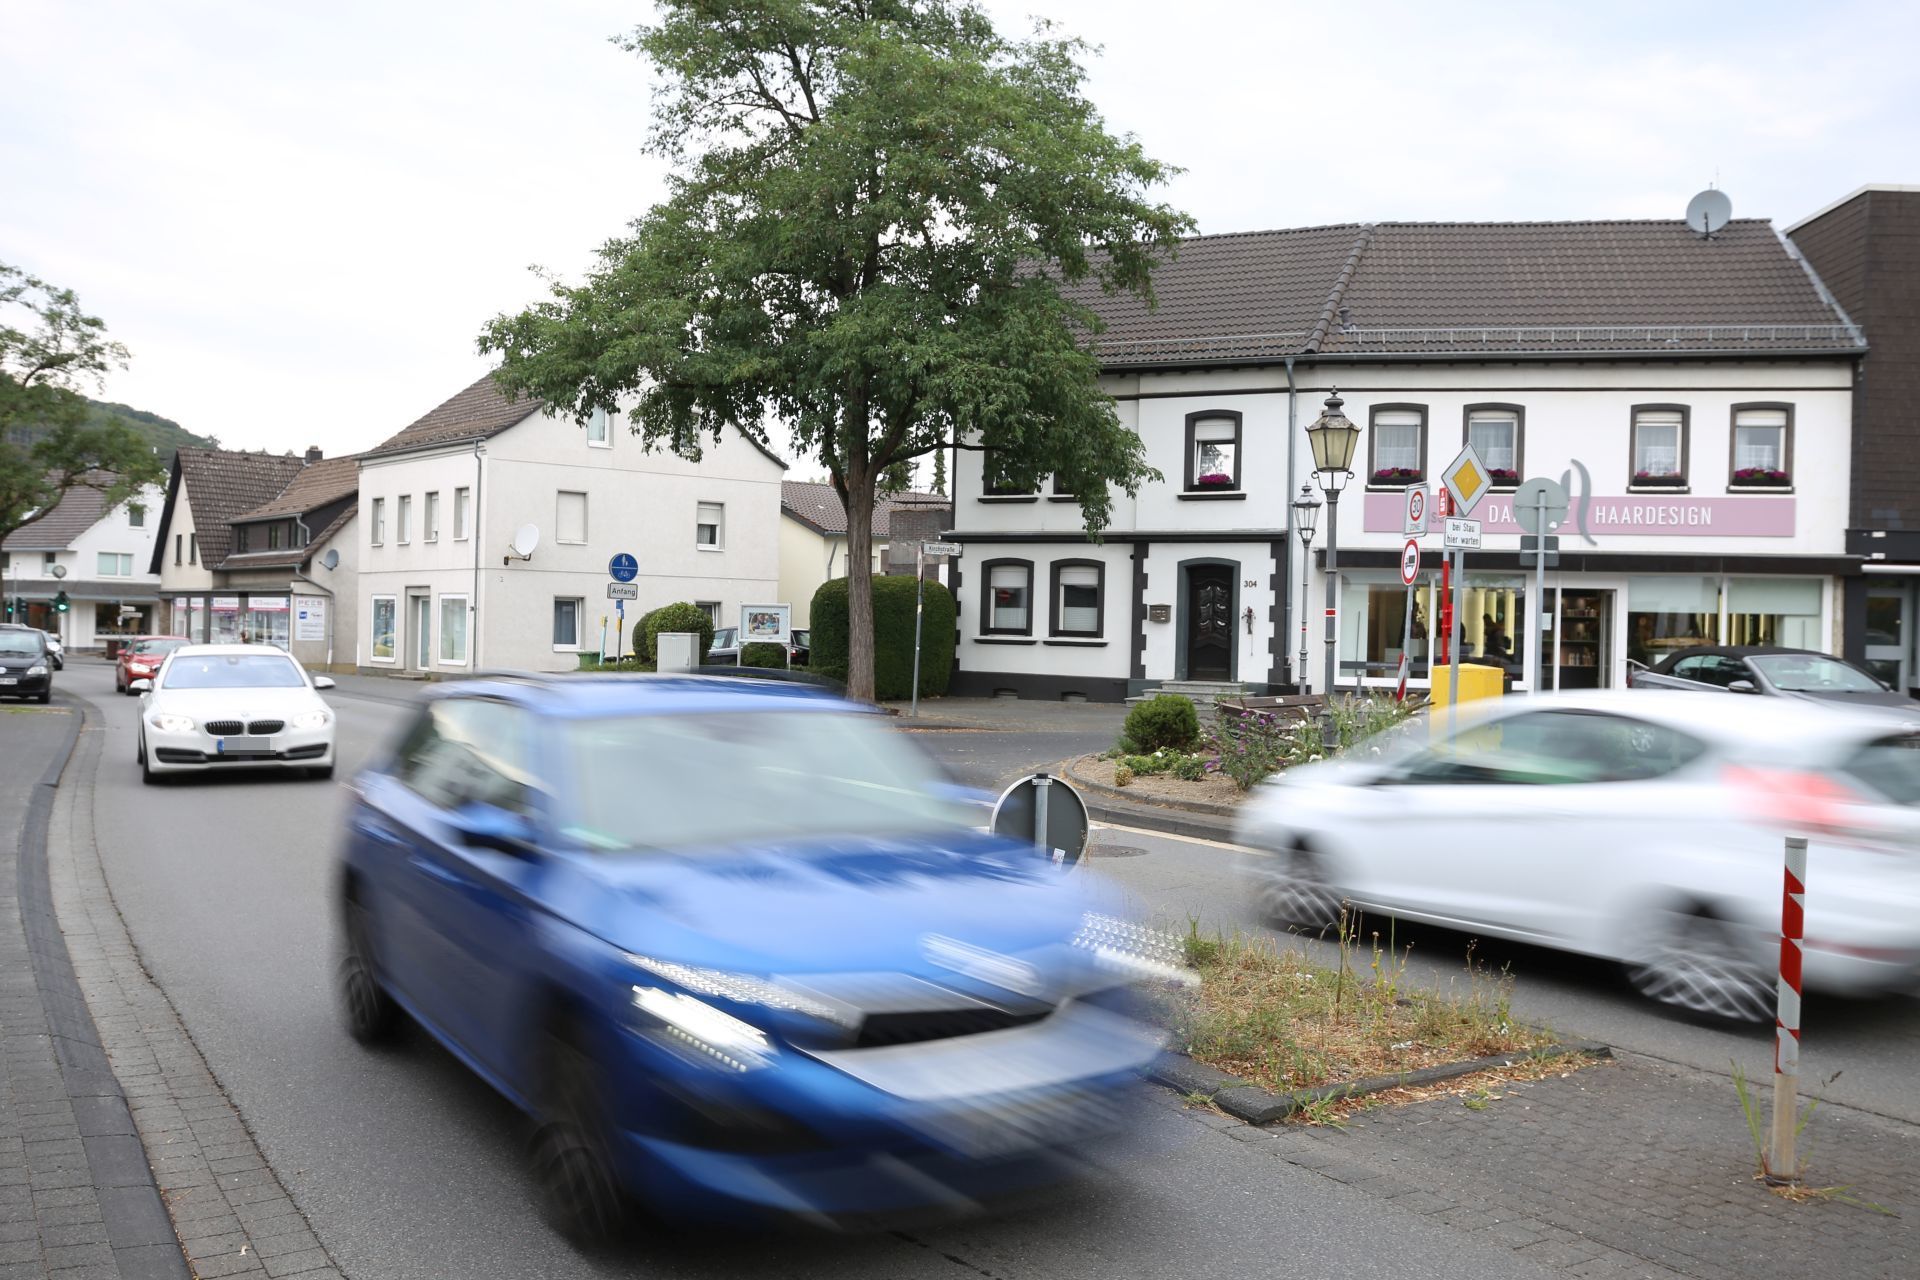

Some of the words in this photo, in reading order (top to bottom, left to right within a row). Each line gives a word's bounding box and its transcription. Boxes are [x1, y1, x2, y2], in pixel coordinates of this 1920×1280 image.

[1412, 499, 1422, 513] 30
[1595, 505, 1712, 525] HAARDESIGN
[1452, 522, 1461, 531] bei
[1463, 522, 1475, 532] Stau
[1446, 534, 1458, 544] hier
[1460, 536, 1479, 545] warten
[1243, 580, 1258, 588] 304
[612, 588, 635, 596] Anfang
